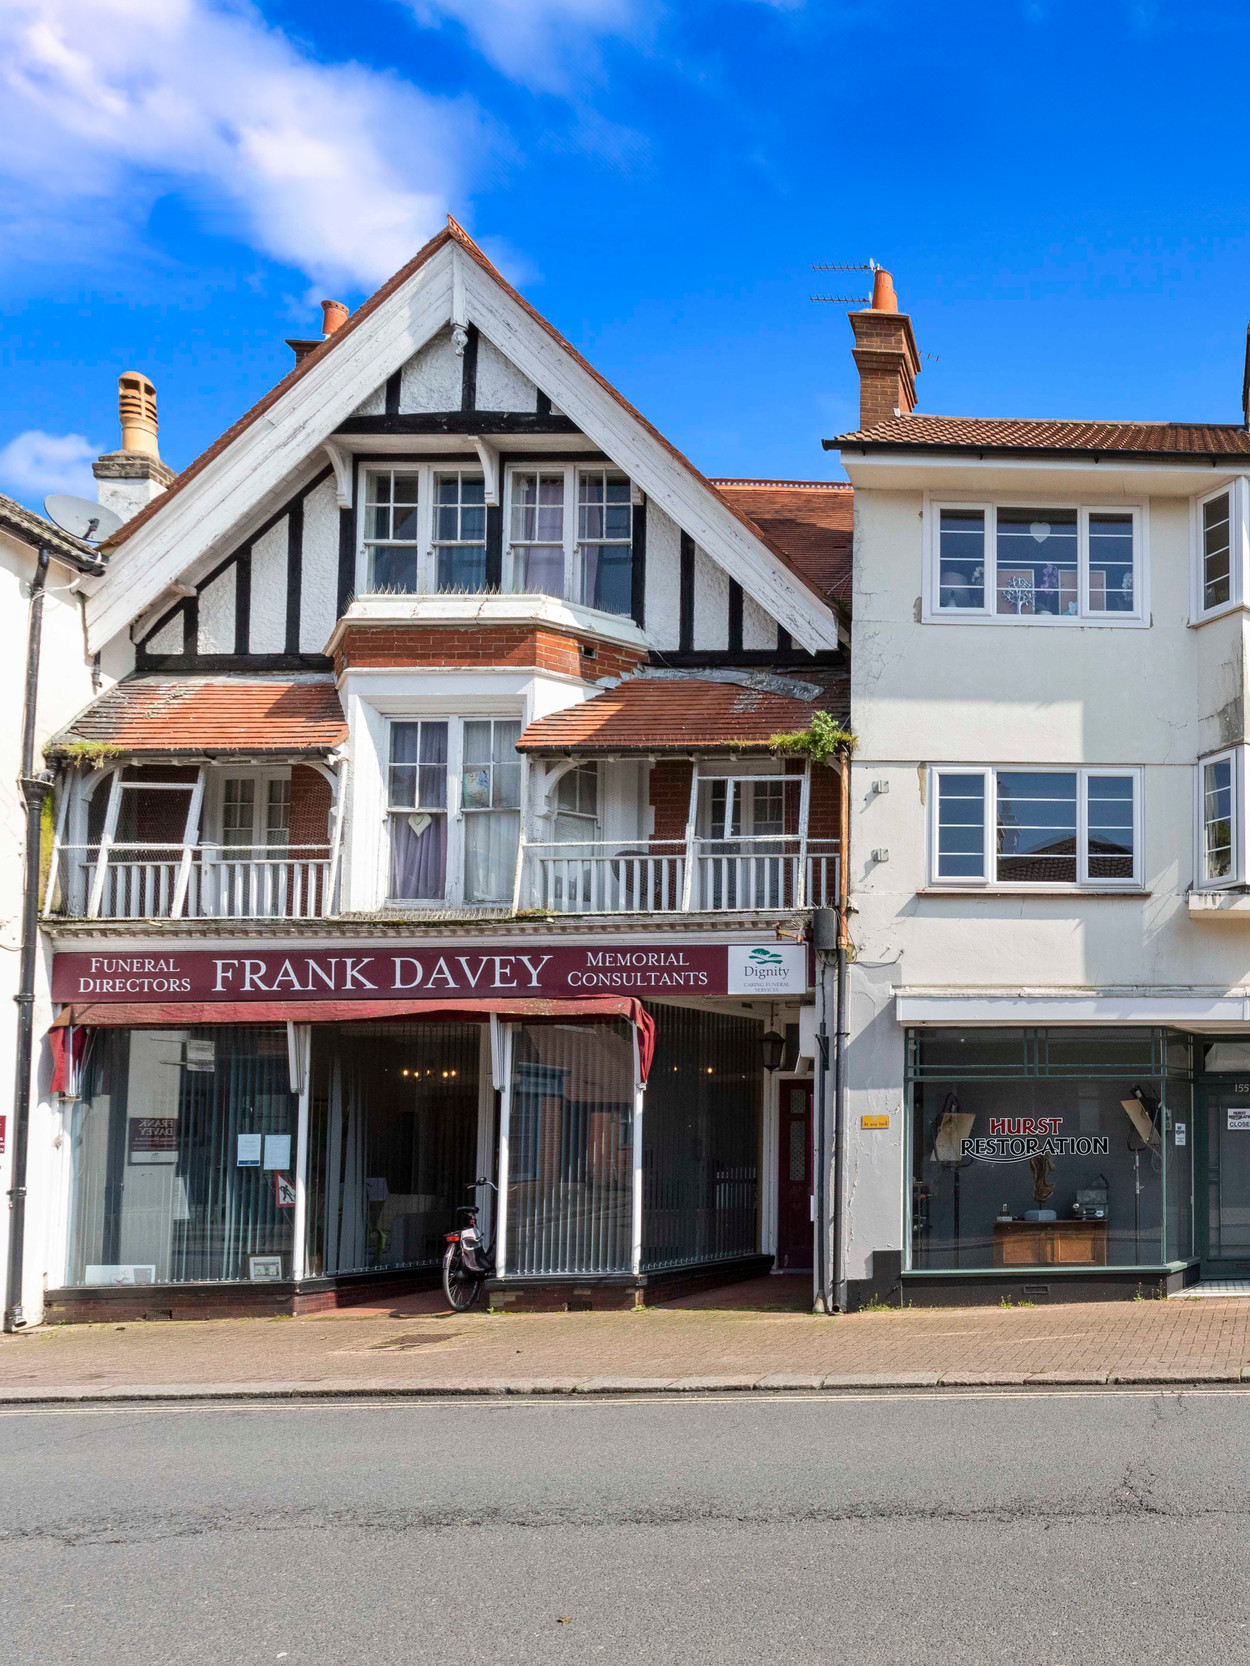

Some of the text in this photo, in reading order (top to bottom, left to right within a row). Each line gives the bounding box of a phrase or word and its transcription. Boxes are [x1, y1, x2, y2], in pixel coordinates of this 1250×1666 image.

[90, 957, 180, 973] FUNERAL
[586, 951, 690, 967] MEMORIAL
[211, 955, 553, 992] FRANK DAVEY
[567, 971, 708, 987] CONSULTANTS
[744, 966, 790, 980] Dignity
[78, 977, 191, 993] DIRECTORS
[1234, 1083, 1250, 1093] 155
[989, 1117, 1064, 1136] HURST
[959, 1137, 1110, 1163] RESTORATION
